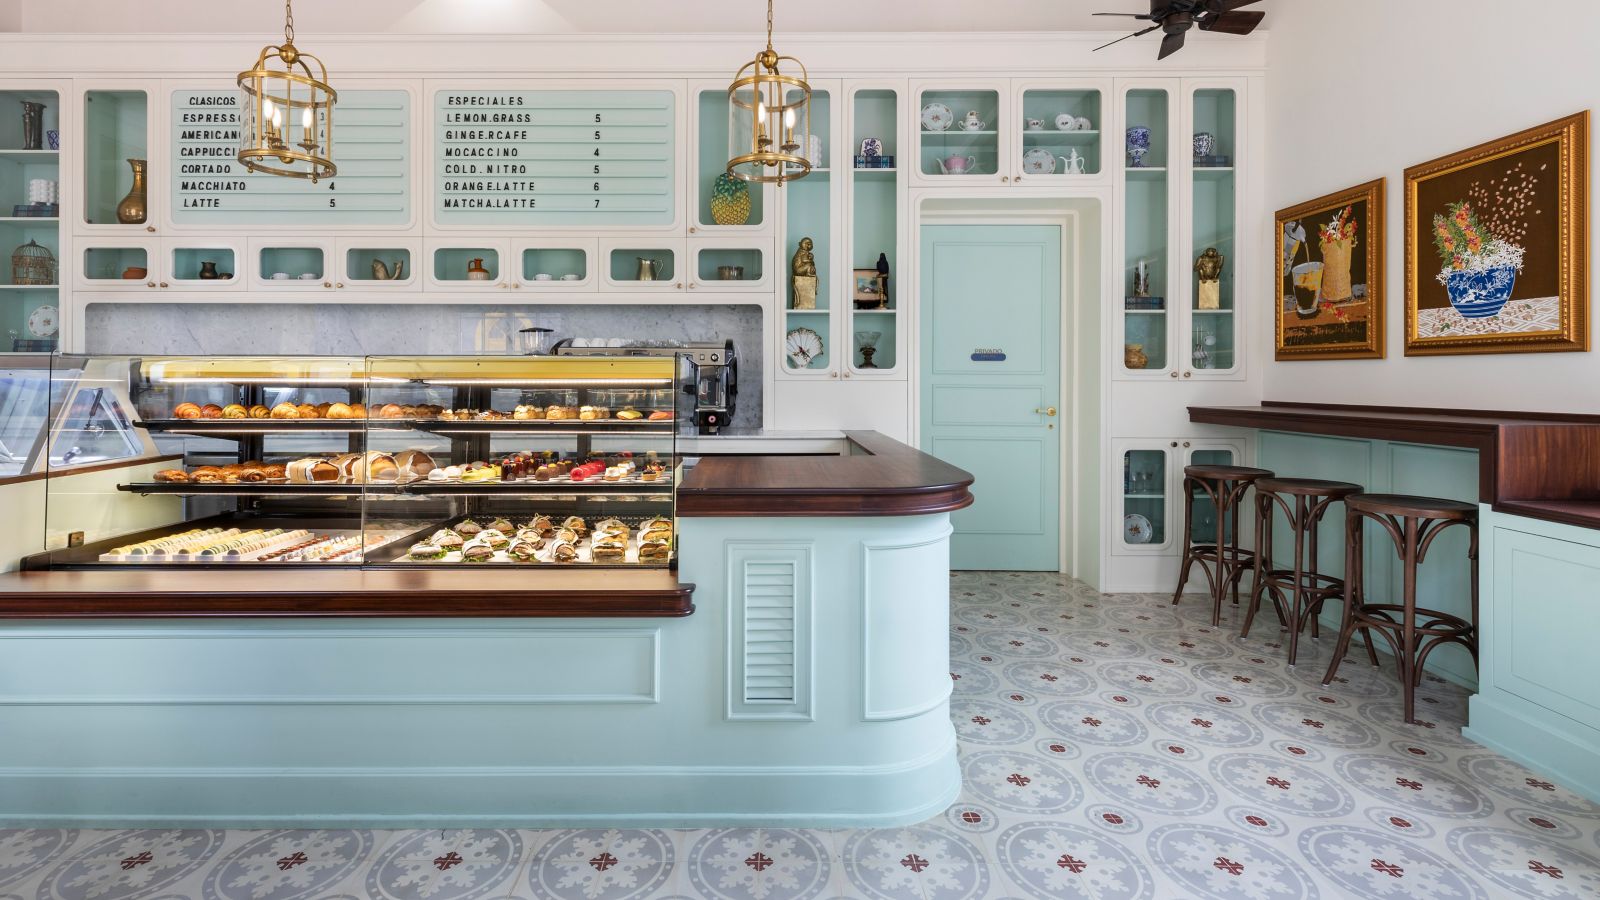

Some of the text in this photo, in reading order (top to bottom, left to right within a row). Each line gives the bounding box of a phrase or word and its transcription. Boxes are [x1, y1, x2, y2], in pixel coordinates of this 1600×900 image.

[189, 97, 236, 106] CLASICOS
[448, 97, 523, 106] ESPECIALES
[182, 114, 241, 123] ESPRESS
[595, 114, 601, 123] 5
[181, 131, 241, 140] AMERICAN
[594, 131, 601, 140] 5
[445, 148, 600, 157] MOCACCINO 4
[181, 165, 231, 174] CORTADO
[593, 165, 600, 174] 5
[181, 182, 335, 191] MACCHIATO 4
[593, 182, 600, 191] 6
[183, 199, 336, 208] LATTE 5
[594, 200, 600, 208] 7
